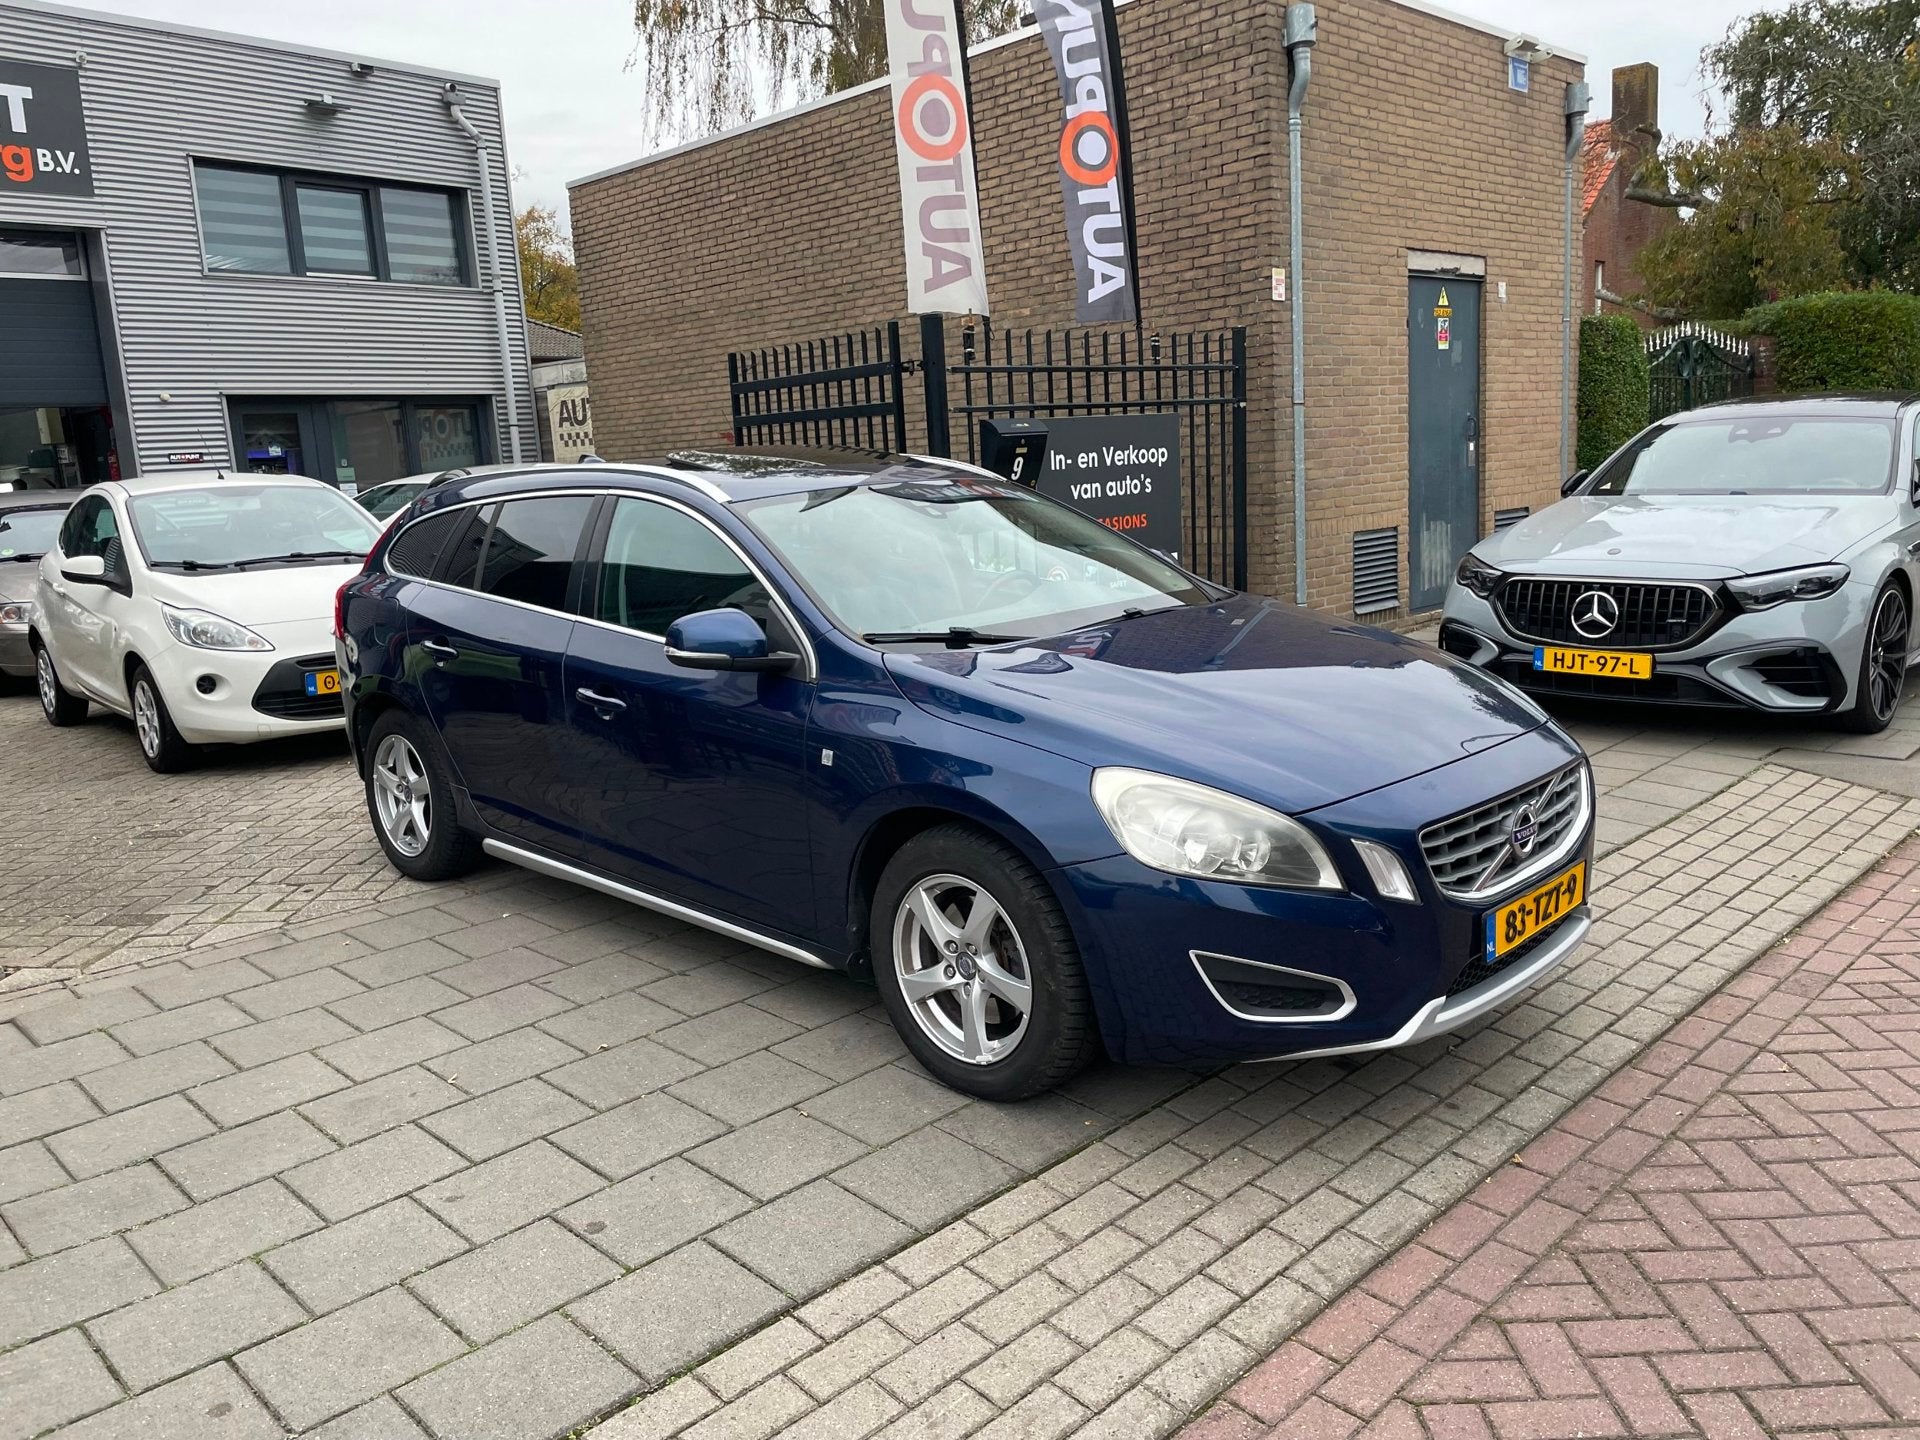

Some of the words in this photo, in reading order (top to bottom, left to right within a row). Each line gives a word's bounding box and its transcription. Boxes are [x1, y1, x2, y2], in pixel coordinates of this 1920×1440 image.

[0, 143, 34, 182] g
[36, 148, 80, 175] B.V.
[559, 398, 590, 428] AU
[1011, 456, 1024, 481] 9
[1050, 450, 1072, 471] In-
[1077, 451, 1098, 469] en
[1102, 444, 1168, 467] Verkoop
[1070, 482, 1101, 500] van
[1105, 474, 1152, 497] auto's
[1096, 513, 1148, 530] ASIONS
[1553, 651, 1640, 675] HJT-97-L
[1486, 941, 1496, 954] NL
[1504, 873, 1578, 943] 83-TZT-9
